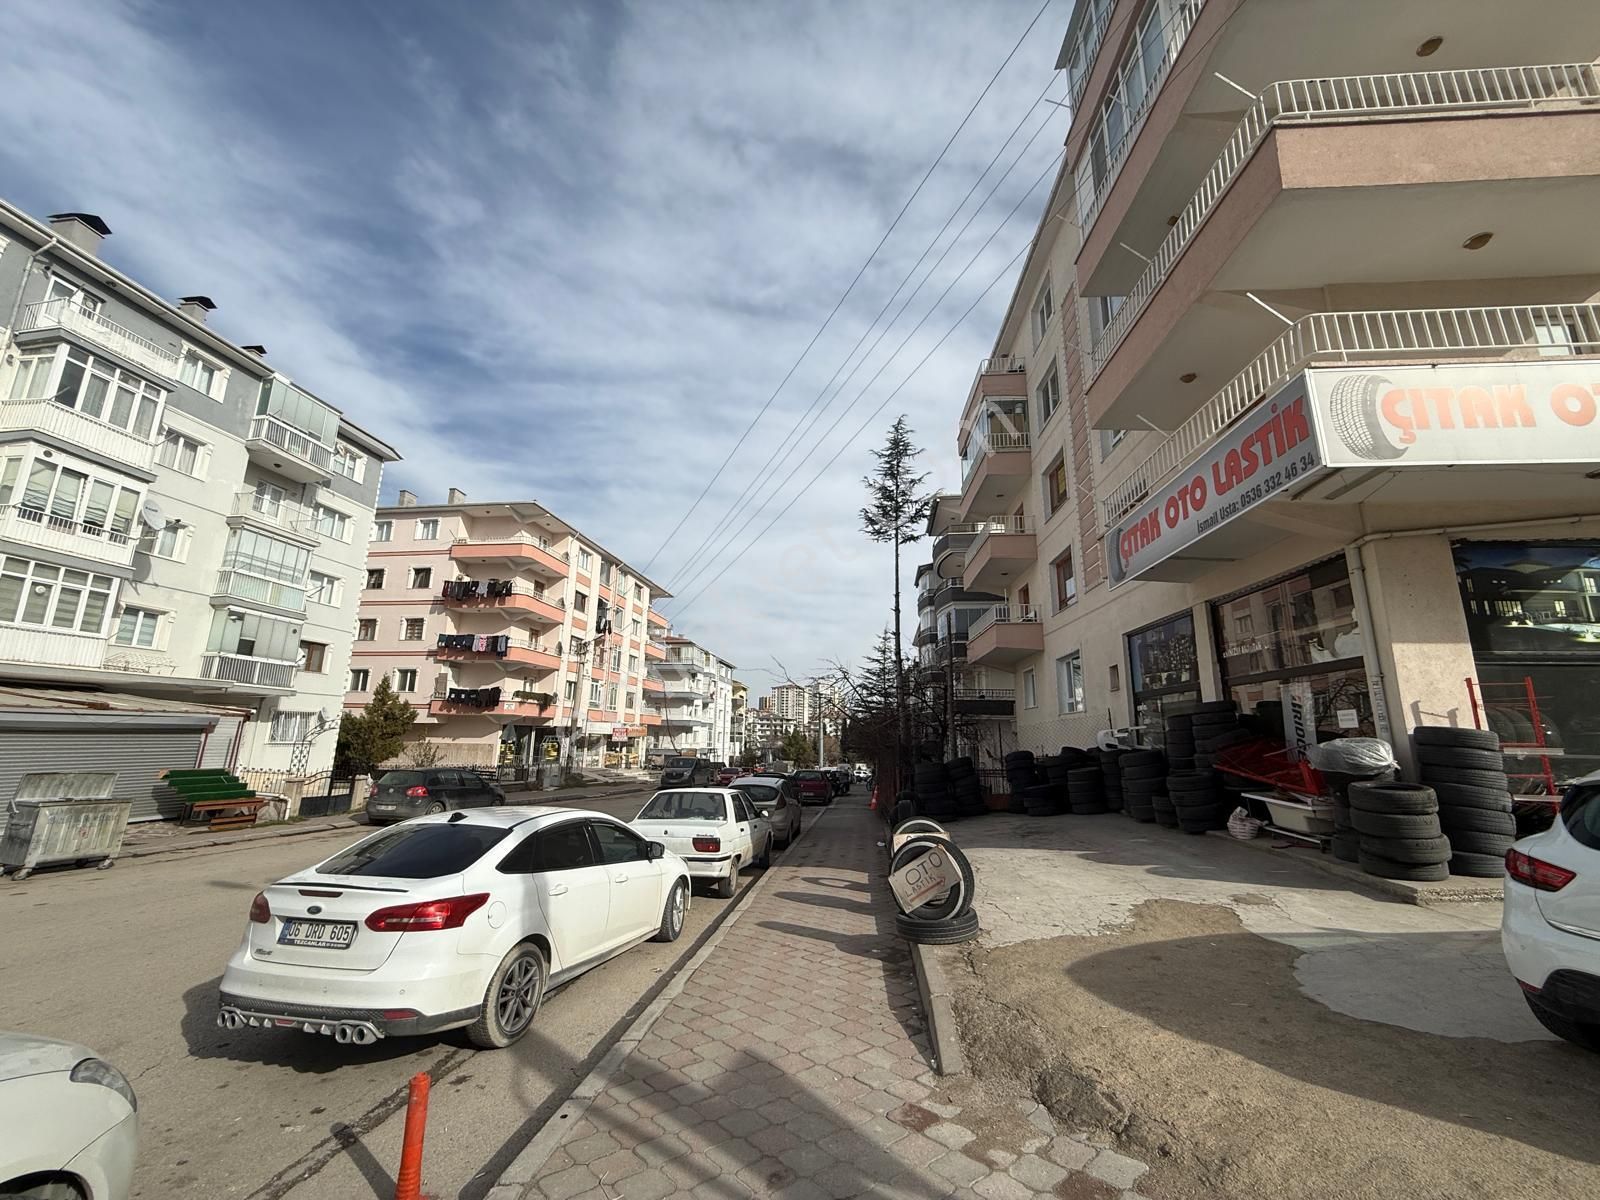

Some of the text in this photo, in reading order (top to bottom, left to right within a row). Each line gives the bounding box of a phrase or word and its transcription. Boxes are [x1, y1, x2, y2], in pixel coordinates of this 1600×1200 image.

[1381, 383, 1600, 445] ÇITAK O
[1120, 395, 1310, 569] ÇITAK OTO LASTİK
[1219, 501, 1240, 520] Usta:
[1240, 484, 1262, 508] 0536
[1263, 471, 1283, 493] 332
[1284, 462, 1298, 481] 46
[1300, 451, 1315, 471] 34
[905, 851, 943, 886] OTO
[288, 922, 302, 937] 06
[329, 925, 351, 941] 605
